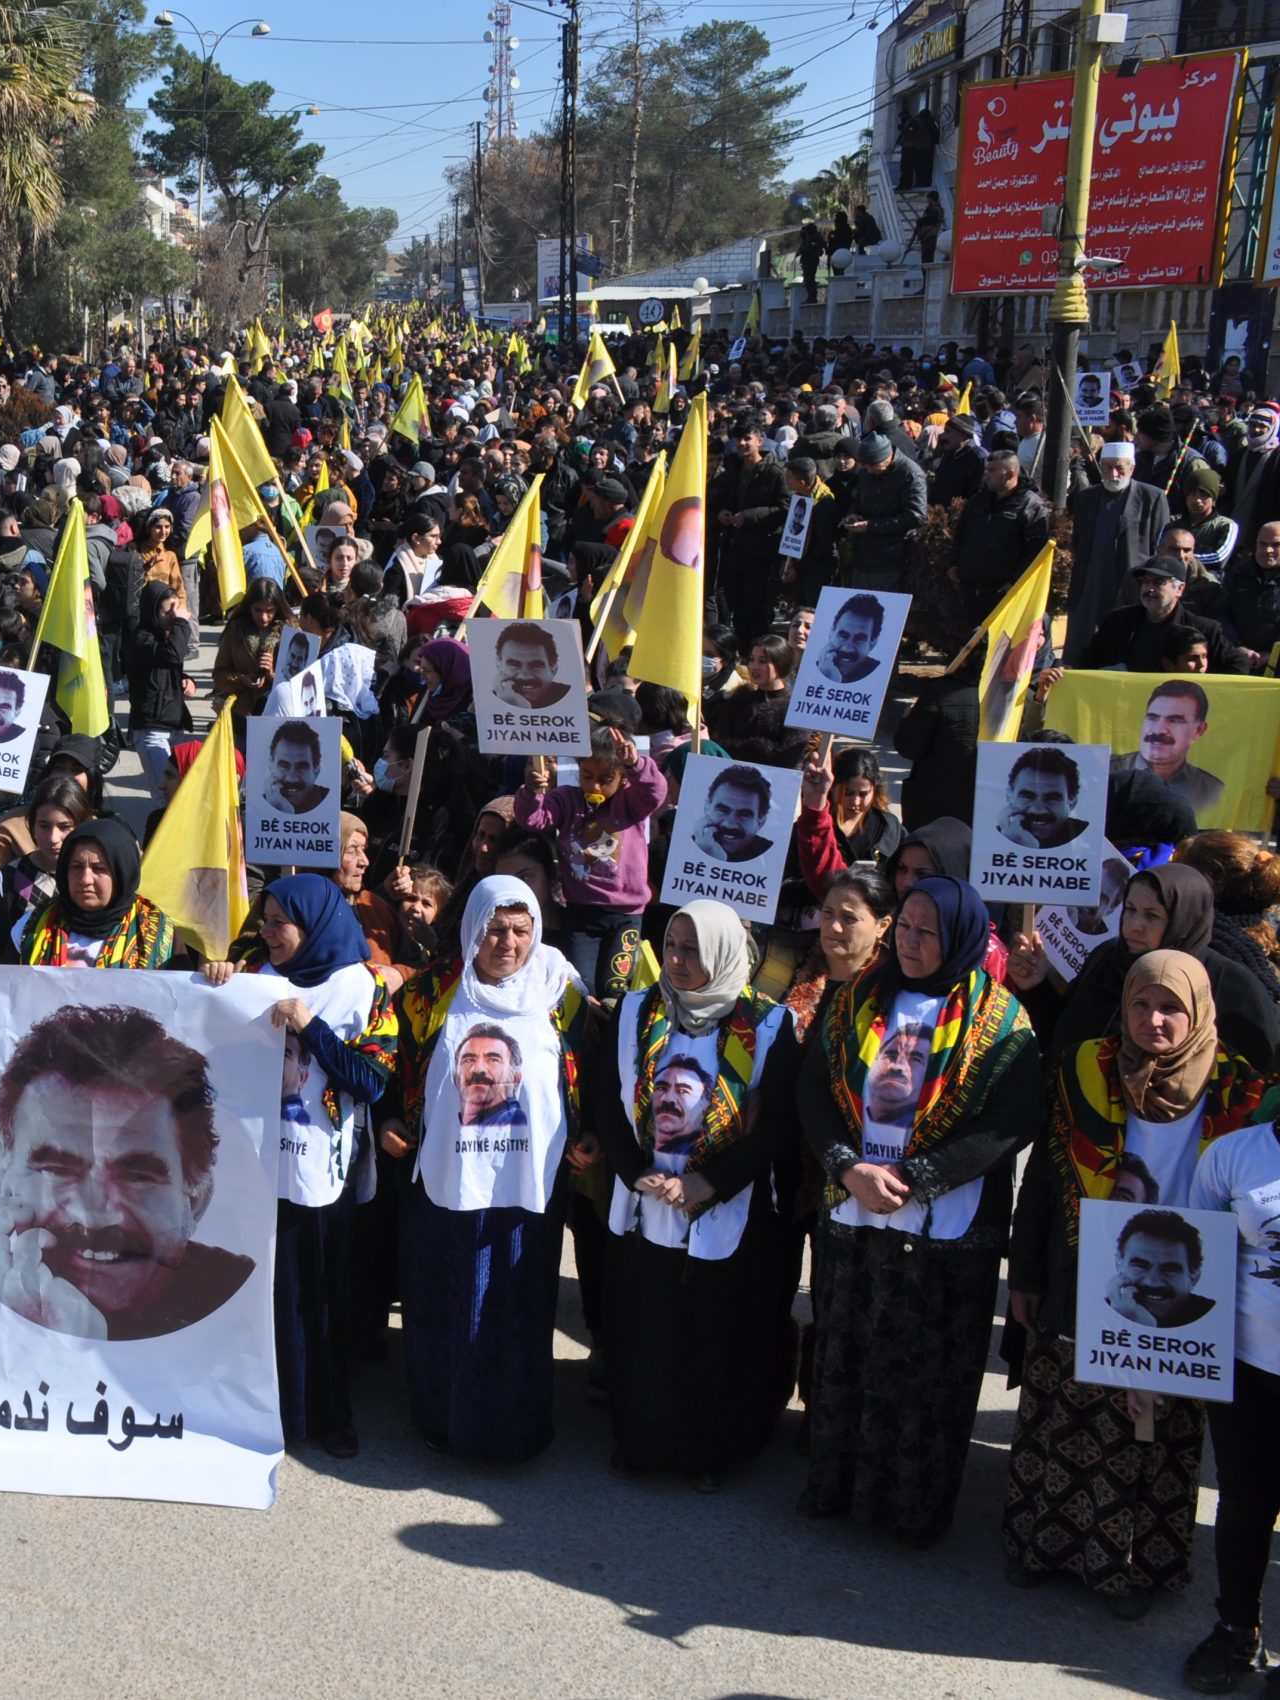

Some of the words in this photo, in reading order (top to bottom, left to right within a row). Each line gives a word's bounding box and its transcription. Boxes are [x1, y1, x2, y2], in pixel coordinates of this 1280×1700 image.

[1179, 71, 1217, 89] مركز
[1099, 92, 1180, 155] بيوتي
[973, 138, 1018, 166] Beauty
[805, 684, 826, 699] BÊ
[826, 688, 872, 706] SEROK
[493, 712, 515, 726] BÊ
[520, 714, 575, 728] SEROK
[794, 700, 832, 717] JIYAN
[833, 706, 871, 723] NABE
[487, 729, 532, 742] JIYAN
[536, 731, 581, 744] NABE
[261, 818, 280, 833] BÊ
[282, 820, 331, 835] SEROK
[254, 836, 293, 850] JIYAN
[296, 838, 334, 852] NABE
[992, 851, 1018, 868] BÊ
[1022, 855, 1088, 872] SEROK
[682, 861, 709, 879] BÊ
[709, 866, 768, 889] SEROK
[982, 871, 1036, 887] JIYAN
[1040, 875, 1091, 891] NABE
[671, 877, 719, 897] JIYAN
[720, 886, 769, 908] NABE
[1036, 920, 1061, 949] JIYAN
[1060, 926, 1089, 961] SEROK
[455, 1138, 489, 1153] DAYIKÊ
[1101, 1329, 1131, 1348] BÊ
[1138, 1334, 1217, 1359] SEROK
[1089, 1350, 1151, 1372] JIYAN
[1158, 1358, 1222, 1381] NABE
[65, 1379, 184, 1451] سوف
